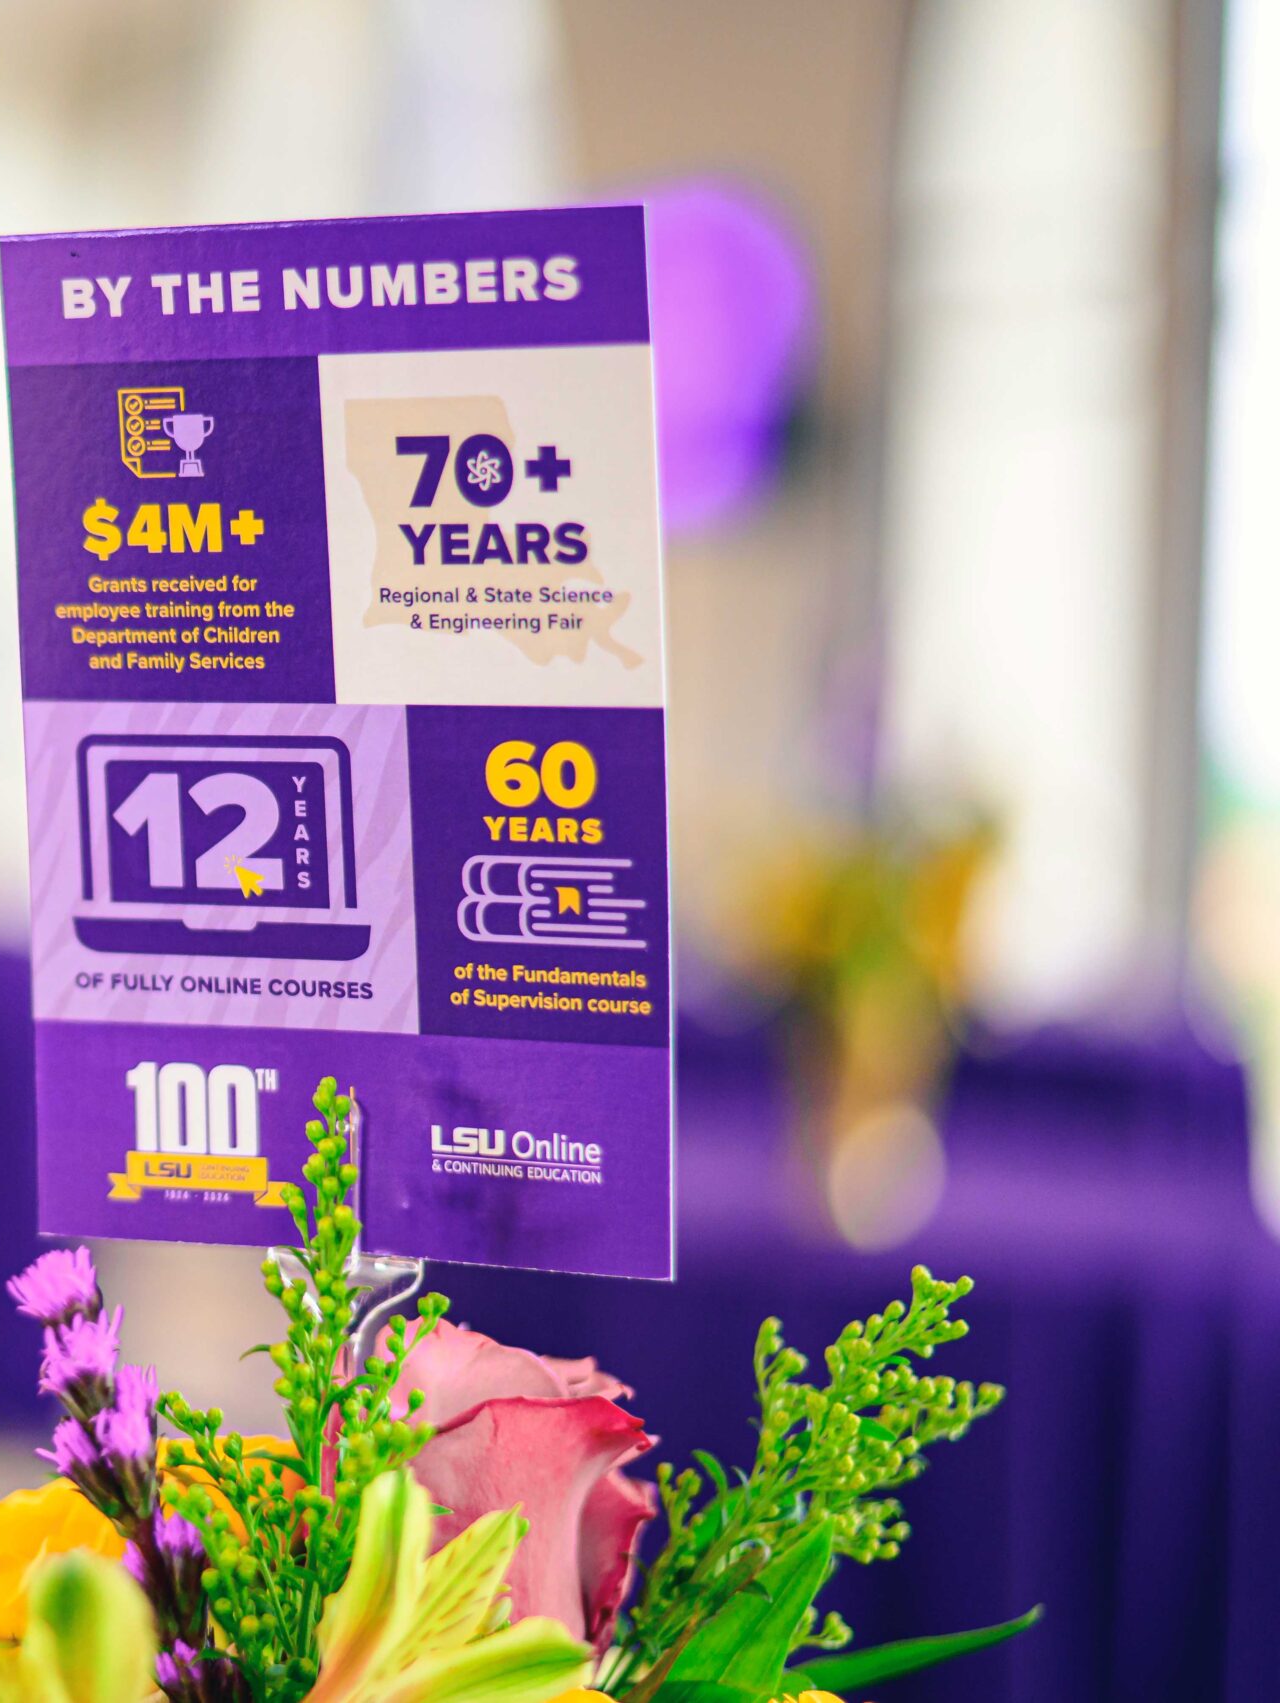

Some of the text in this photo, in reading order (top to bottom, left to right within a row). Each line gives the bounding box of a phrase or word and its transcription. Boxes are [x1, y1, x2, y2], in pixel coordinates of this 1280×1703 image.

[61, 257, 581, 319] BY THE NUMBERS
[395, 433, 572, 507] 70+
[81, 499, 264, 561] $4M+
[398, 521, 588, 566] YEARS
[88, 574, 258, 593] Grants received for
[379, 586, 614, 606] Regional & State Science
[55, 601, 295, 622] employee training from the
[410, 613, 583, 633] & Engineering Fair
[71, 626, 281, 647] Department of Children
[89, 652, 266, 673] and Family Services
[484, 740, 597, 809] 60
[112, 771, 284, 890] 12
[291, 775, 312, 890] YEARS
[483, 816, 604, 844] YEARS
[75, 971, 374, 1000] OF FULLY ONLINE COURSES
[454, 963, 647, 988] of the Fundamentals
[450, 989, 652, 1015] of Supervision course
[431, 1124, 602, 1163] LSU Online
[144, 1161, 192, 1179] LSU
[431, 1159, 602, 1184] & CONTINUING EDUCATION
